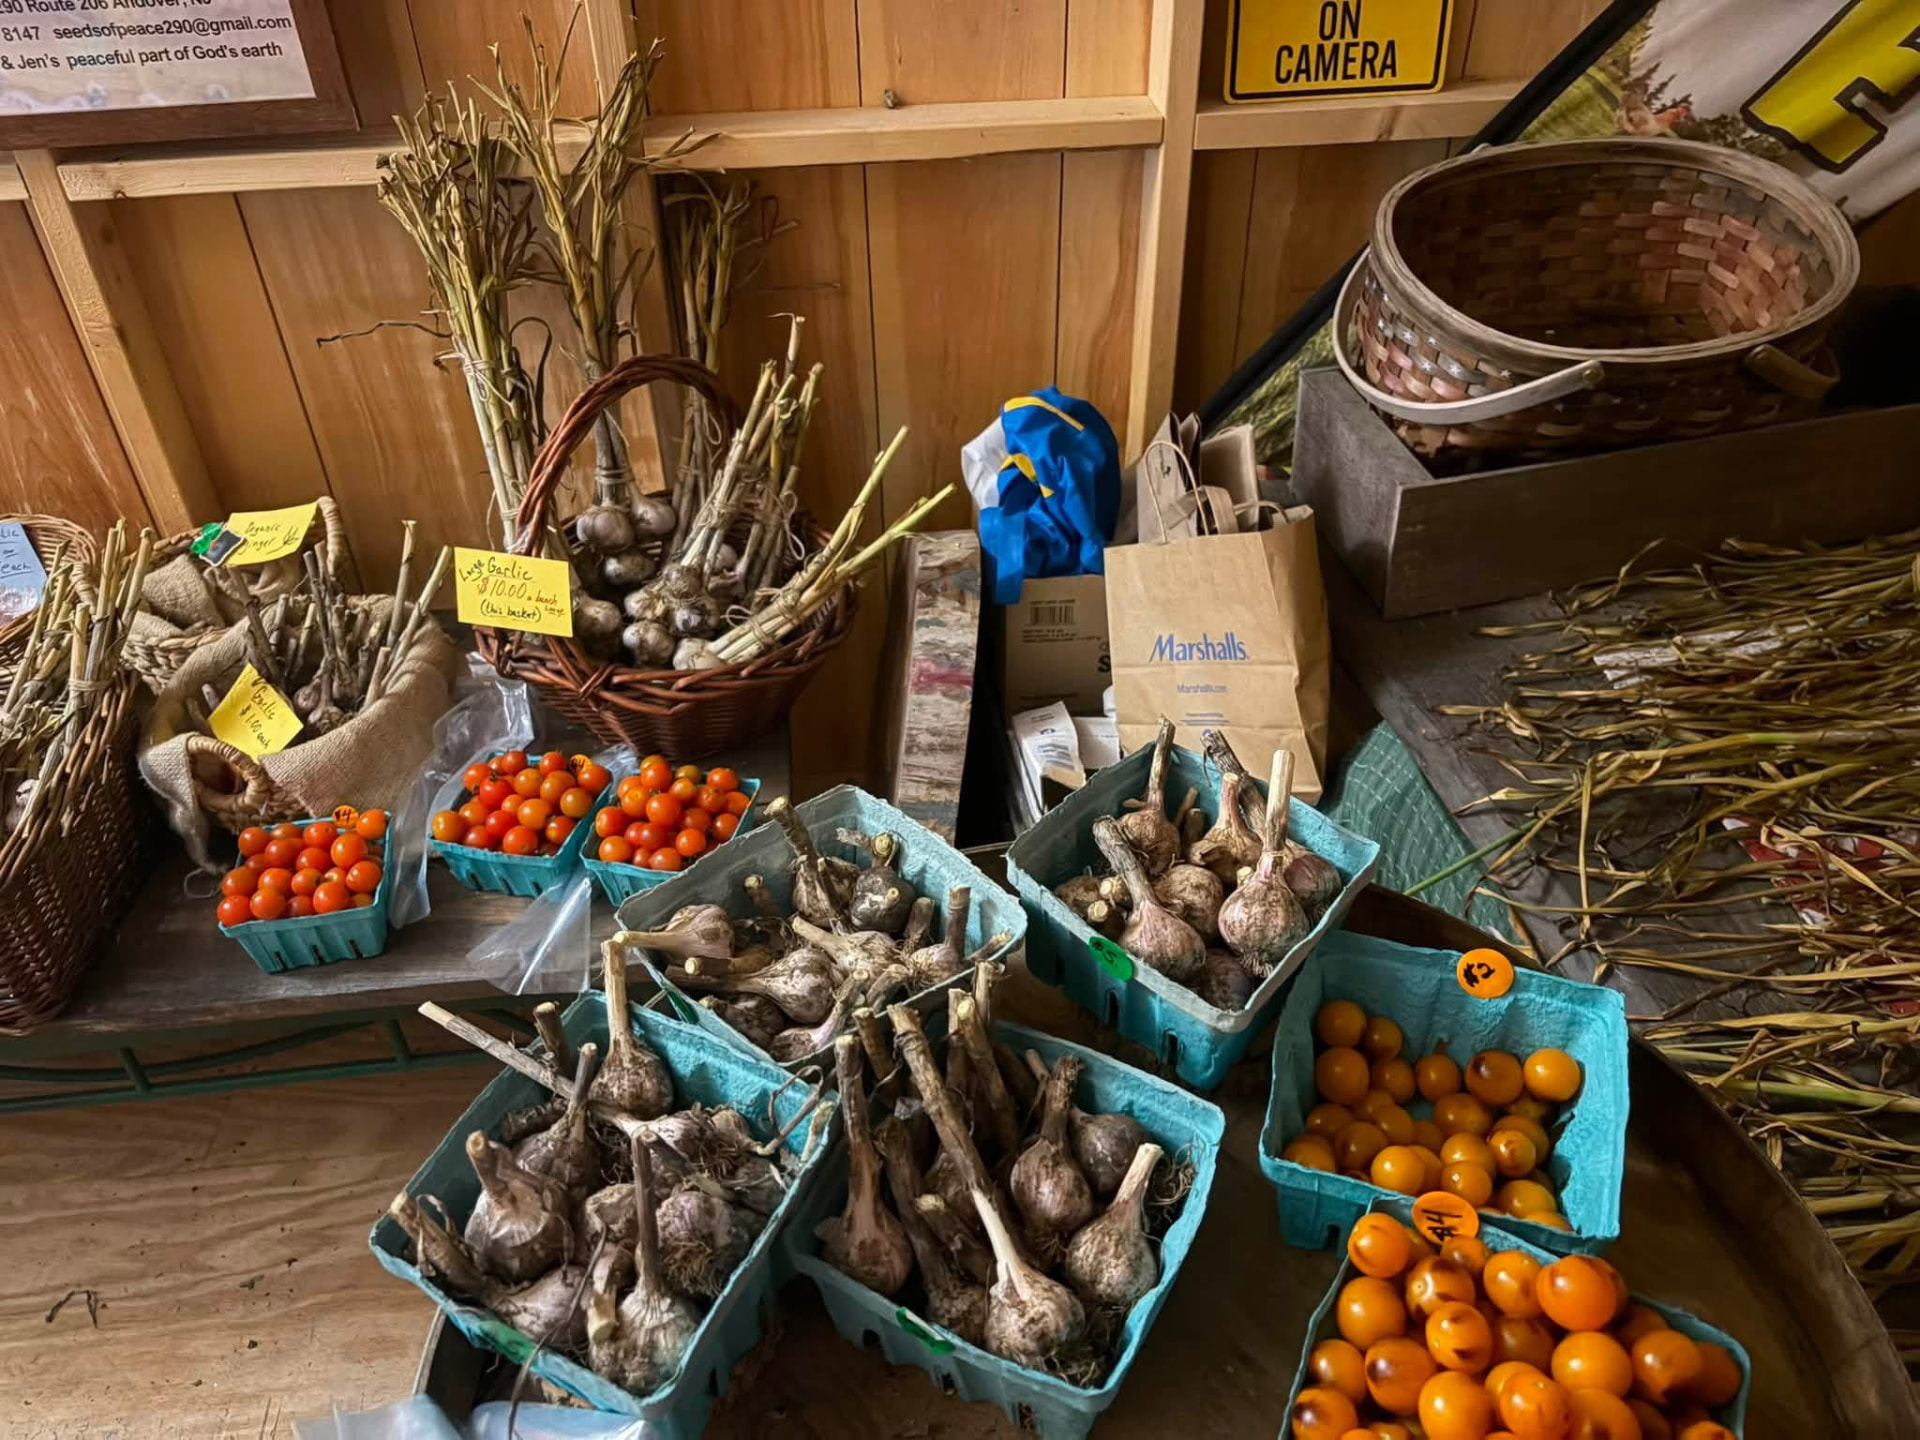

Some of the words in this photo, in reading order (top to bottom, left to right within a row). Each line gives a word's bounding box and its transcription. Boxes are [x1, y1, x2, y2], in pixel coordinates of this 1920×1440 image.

[0, 0, 23, 13] 90
[25, 0, 75, 12] Route
[1319, 0, 1362, 41] ON
[1, 26, 39, 41] 8147
[52, 16, 292, 39] seedsofpeace290@gmail.com
[1, 55, 15, 70] &
[17, 53, 60, 69] Jen's
[66, 49, 136, 70] peaceful
[138, 48, 172, 66] part
[174, 46, 190, 60] of
[192, 45, 239, 59] God's
[241, 41, 283, 57] earth
[1275, 40, 1397, 84] CAMERA
[488, 557, 533, 580] Garlic
[1149, 631, 1250, 662] Marshalls
